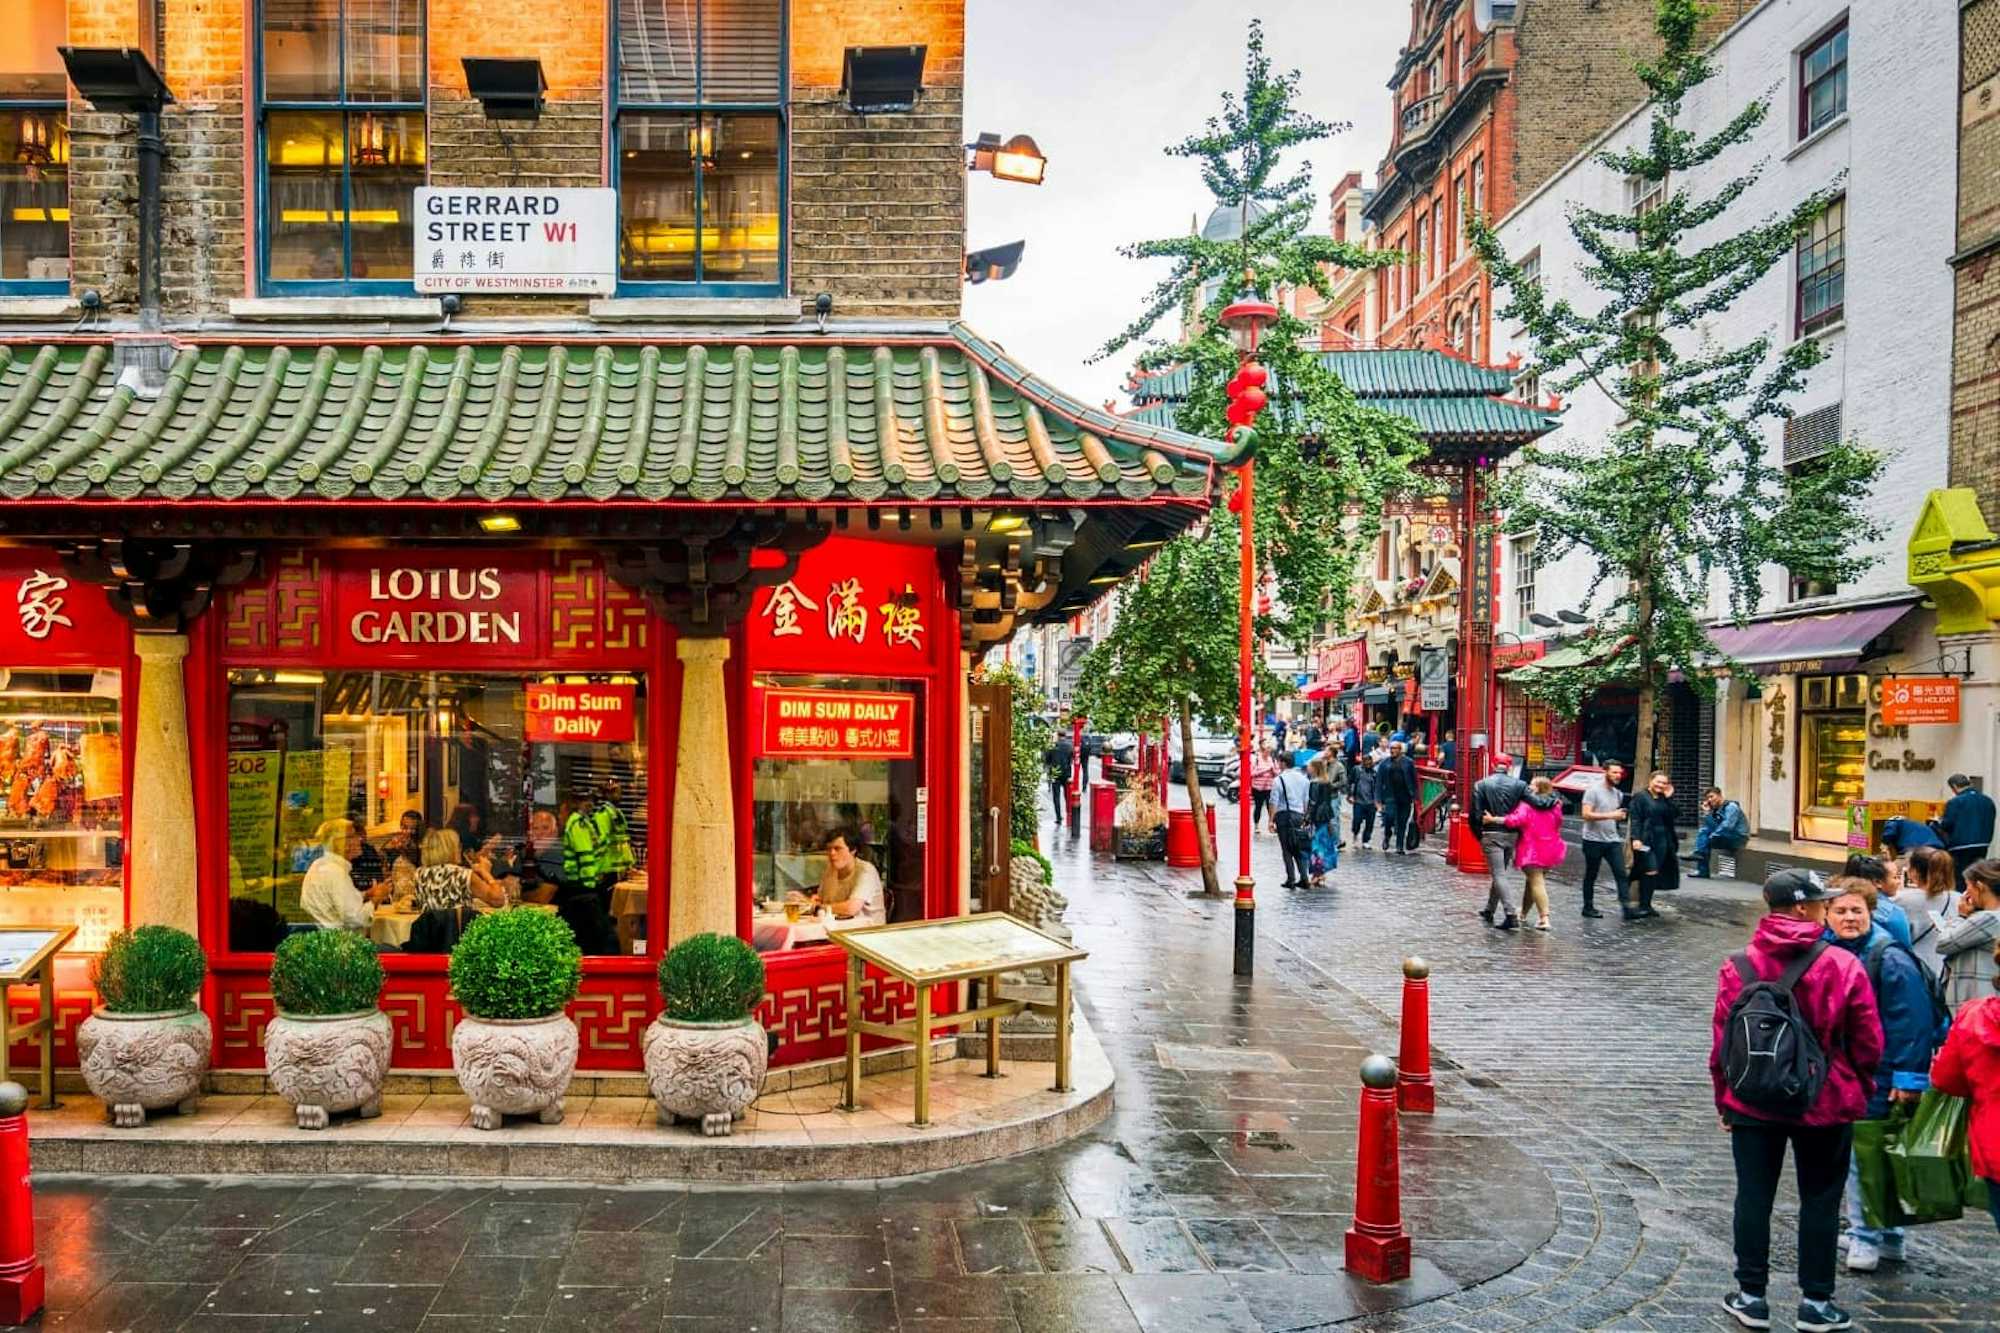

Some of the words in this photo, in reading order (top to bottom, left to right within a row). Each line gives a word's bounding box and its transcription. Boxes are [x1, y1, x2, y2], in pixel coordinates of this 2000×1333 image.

[427, 196, 560, 215] GERRARD
[427, 222, 531, 242] STREET
[543, 222, 577, 242] W1
[424, 278, 451, 288] CITY
[455, 278, 471, 288] OF
[475, 278, 565, 288] WESTMINSTER
[370, 568, 501, 600] LOTUS
[17, 569, 73, 638] 家
[351, 611, 521, 643] GARDEN
[538, 693, 576, 710] Dim
[578, 692, 622, 710] Sum
[780, 701, 811, 718] DIM
[815, 702, 850, 719] SUM
[855, 704, 898, 720] DAILY
[554, 716, 603, 736] Daily
